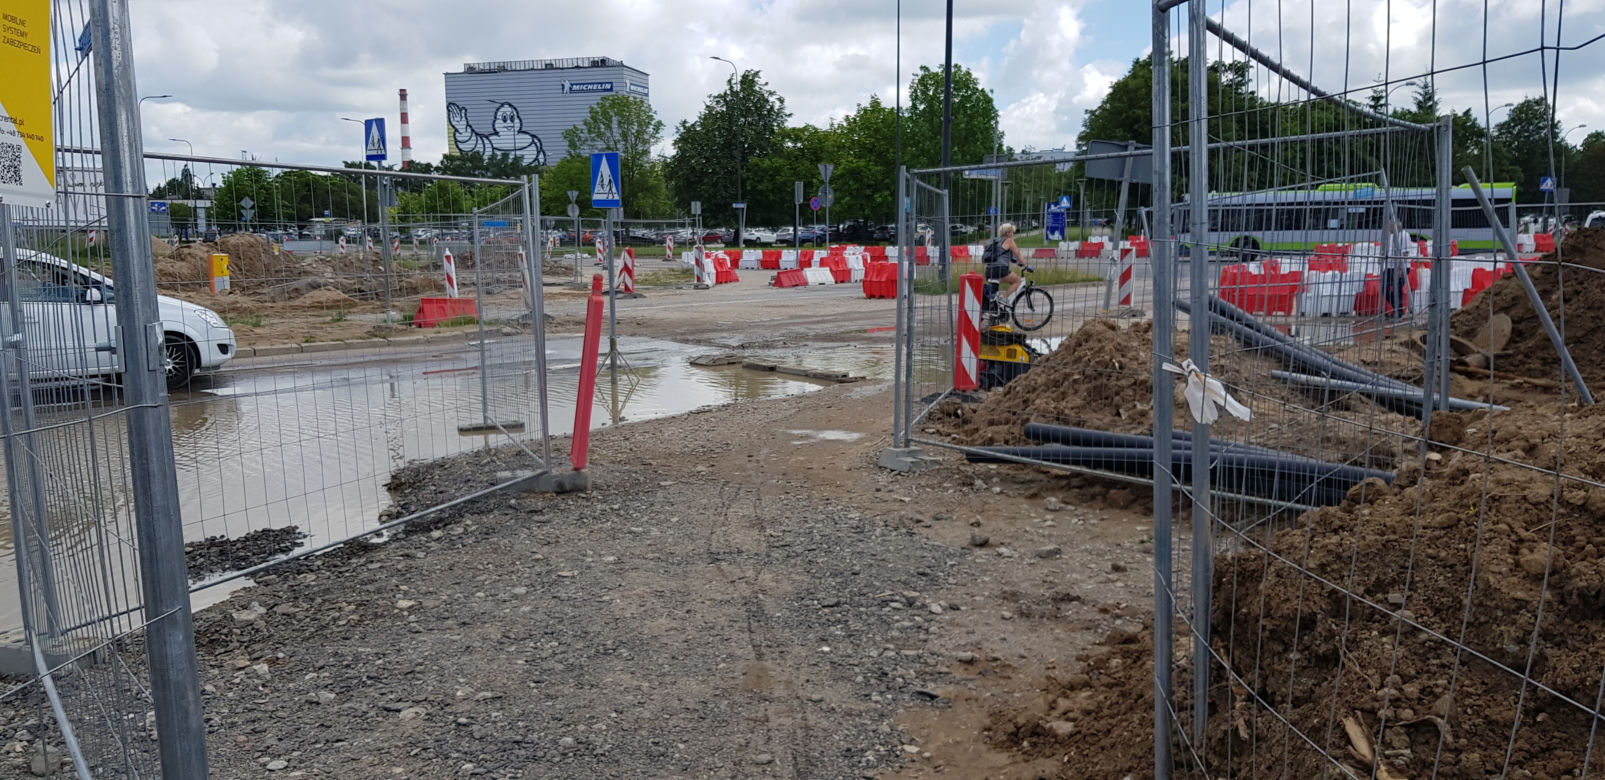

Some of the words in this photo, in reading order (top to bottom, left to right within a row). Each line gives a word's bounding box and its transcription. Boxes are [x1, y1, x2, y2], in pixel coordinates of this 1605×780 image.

[2, 12, 27, 28] MOBILNE
[2, 24, 28, 38] SYSTEMY
[572, 83, 612, 91] MICHELIN
